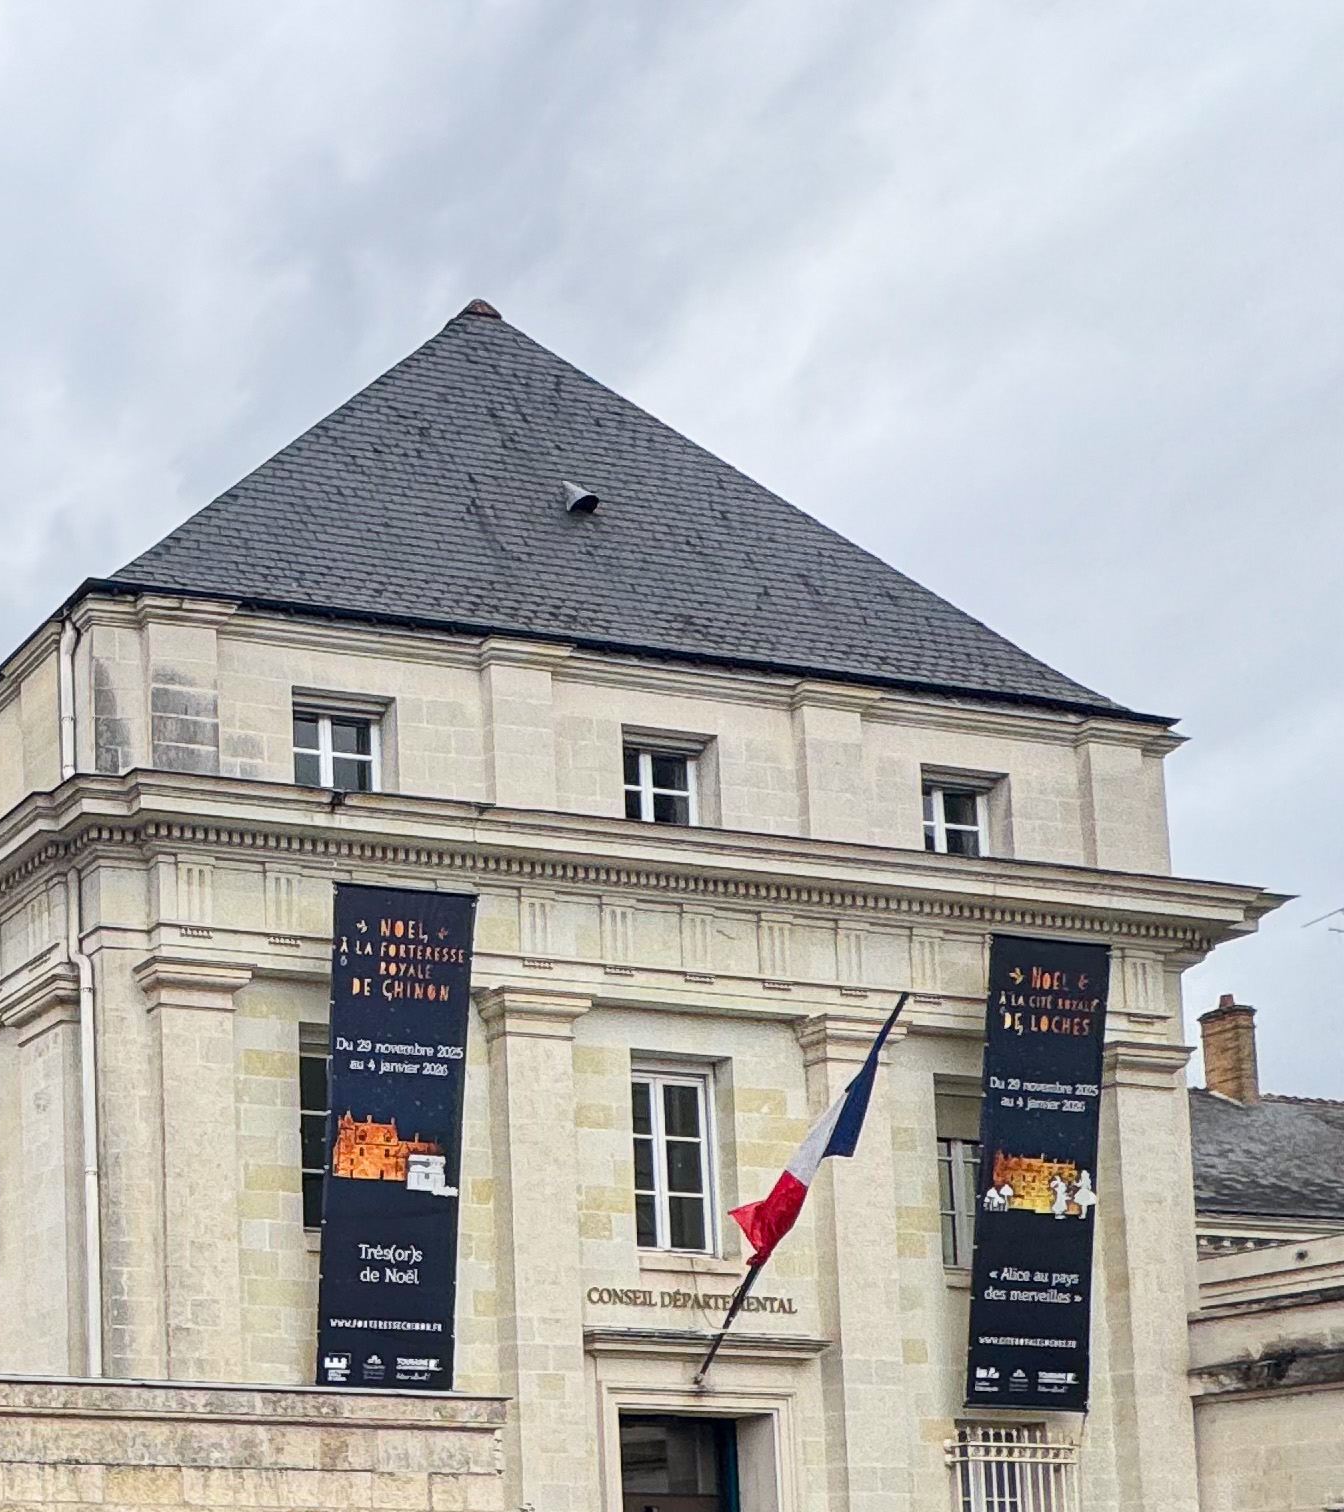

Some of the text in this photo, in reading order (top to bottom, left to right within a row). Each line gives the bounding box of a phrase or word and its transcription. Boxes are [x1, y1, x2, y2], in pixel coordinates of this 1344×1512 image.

[356, 941, 465, 963] LA FORTERESSE
[379, 962, 433, 979] ROYALE
[352, 978, 372, 996] DE
[1012, 991, 1024, 1006] LA
[1004, 1012, 1090, 1035] DE LOCHES
[336, 1037, 464, 1059] Du 29 novembre 2025
[350, 1059, 448, 1076] au 4 janvier 2026
[990, 1076, 1005, 1089] Du
[1007, 1079, 1020, 1090] 29
[1023, 1081, 1073, 1094] novembre
[1000, 1097, 1014, 1106] au
[1016, 1097, 1023, 1107] 4
[1026, 1097, 1061, 1110] janvier
[358, 1243, 423, 1264] Trés(or)s
[360, 1266, 419, 1284] de Noël
[1000, 1267, 1080, 1287] Alice au pays
[587, 1287, 657, 1307] CONSEIL
[984, 1286, 1007, 1300] des
[1010, 1289, 1071, 1304] merveilles
